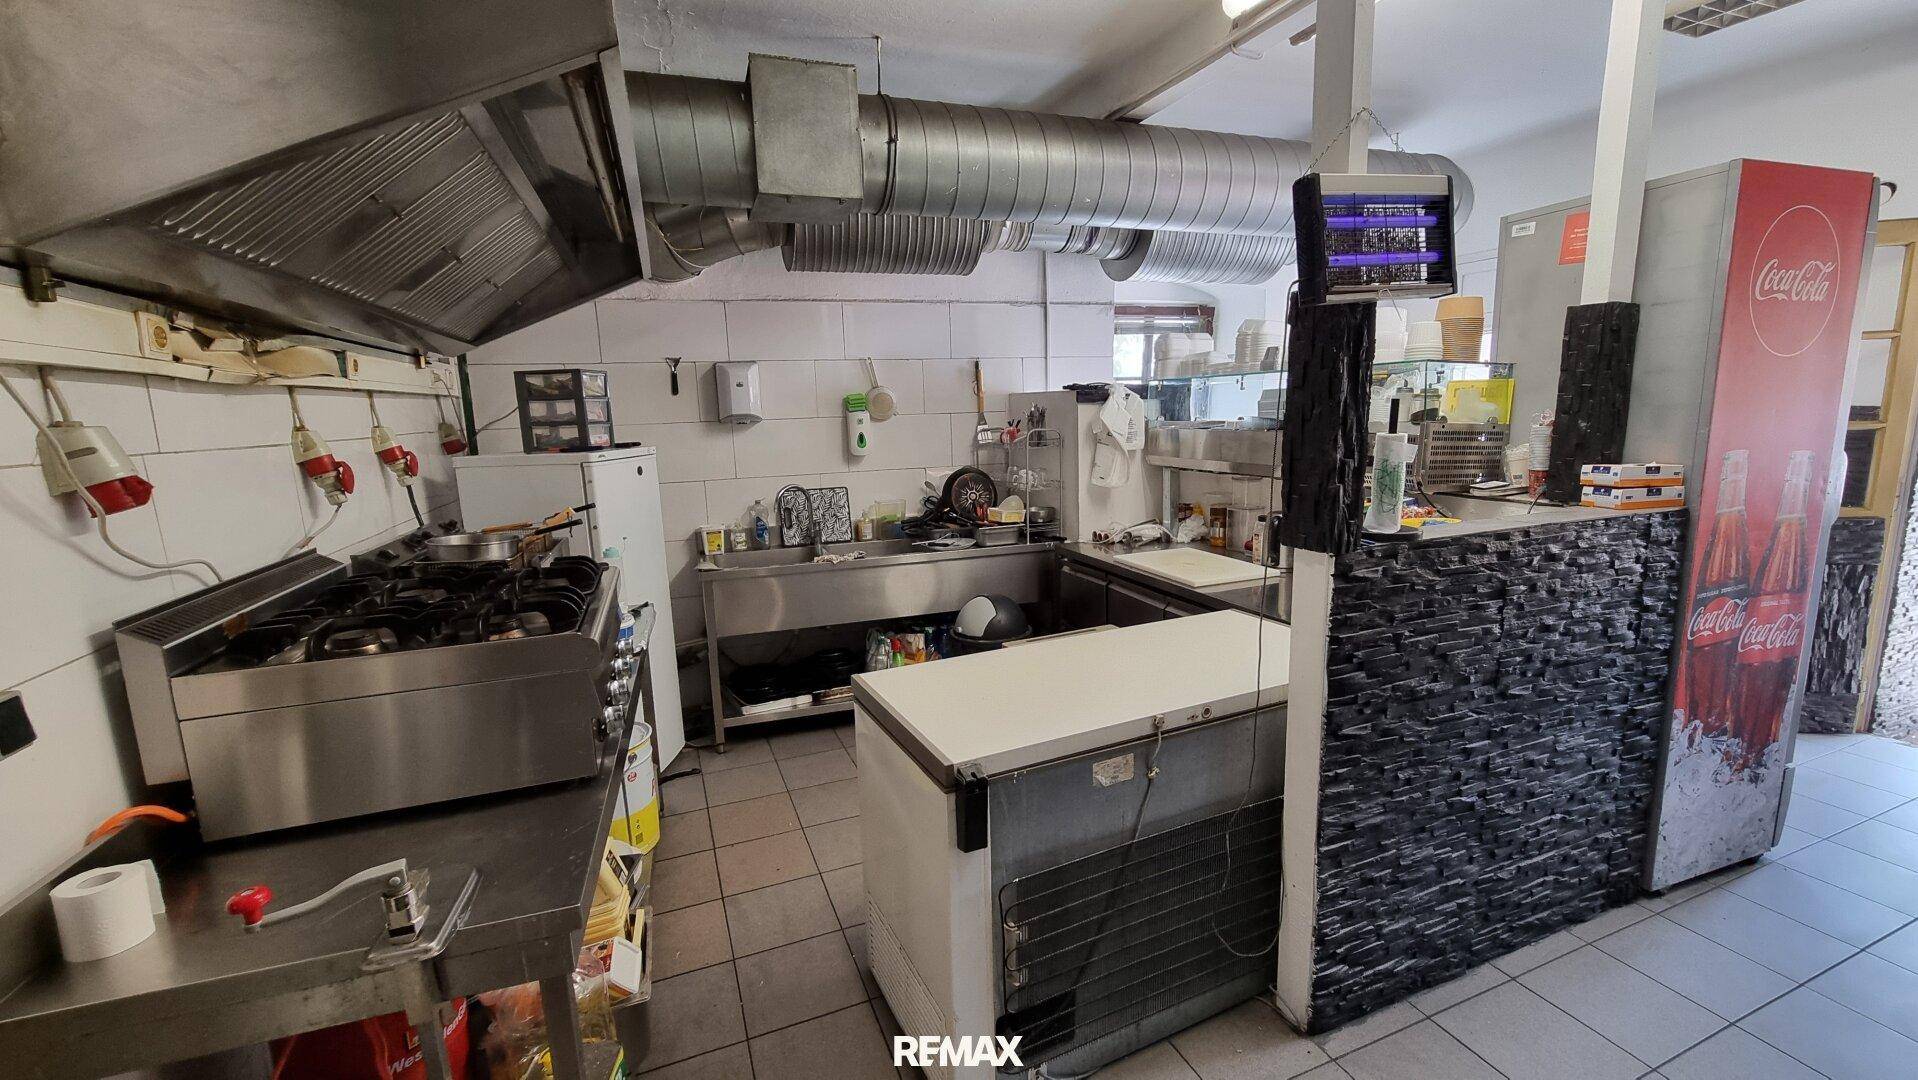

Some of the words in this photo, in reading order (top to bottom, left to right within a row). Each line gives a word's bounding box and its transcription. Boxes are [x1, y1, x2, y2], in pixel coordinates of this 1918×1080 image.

[1755, 258, 1837, 302] Coca-Cola
[1687, 597, 1749, 640] Coca-Cola
[1737, 613, 1805, 653] Coca-Cola
